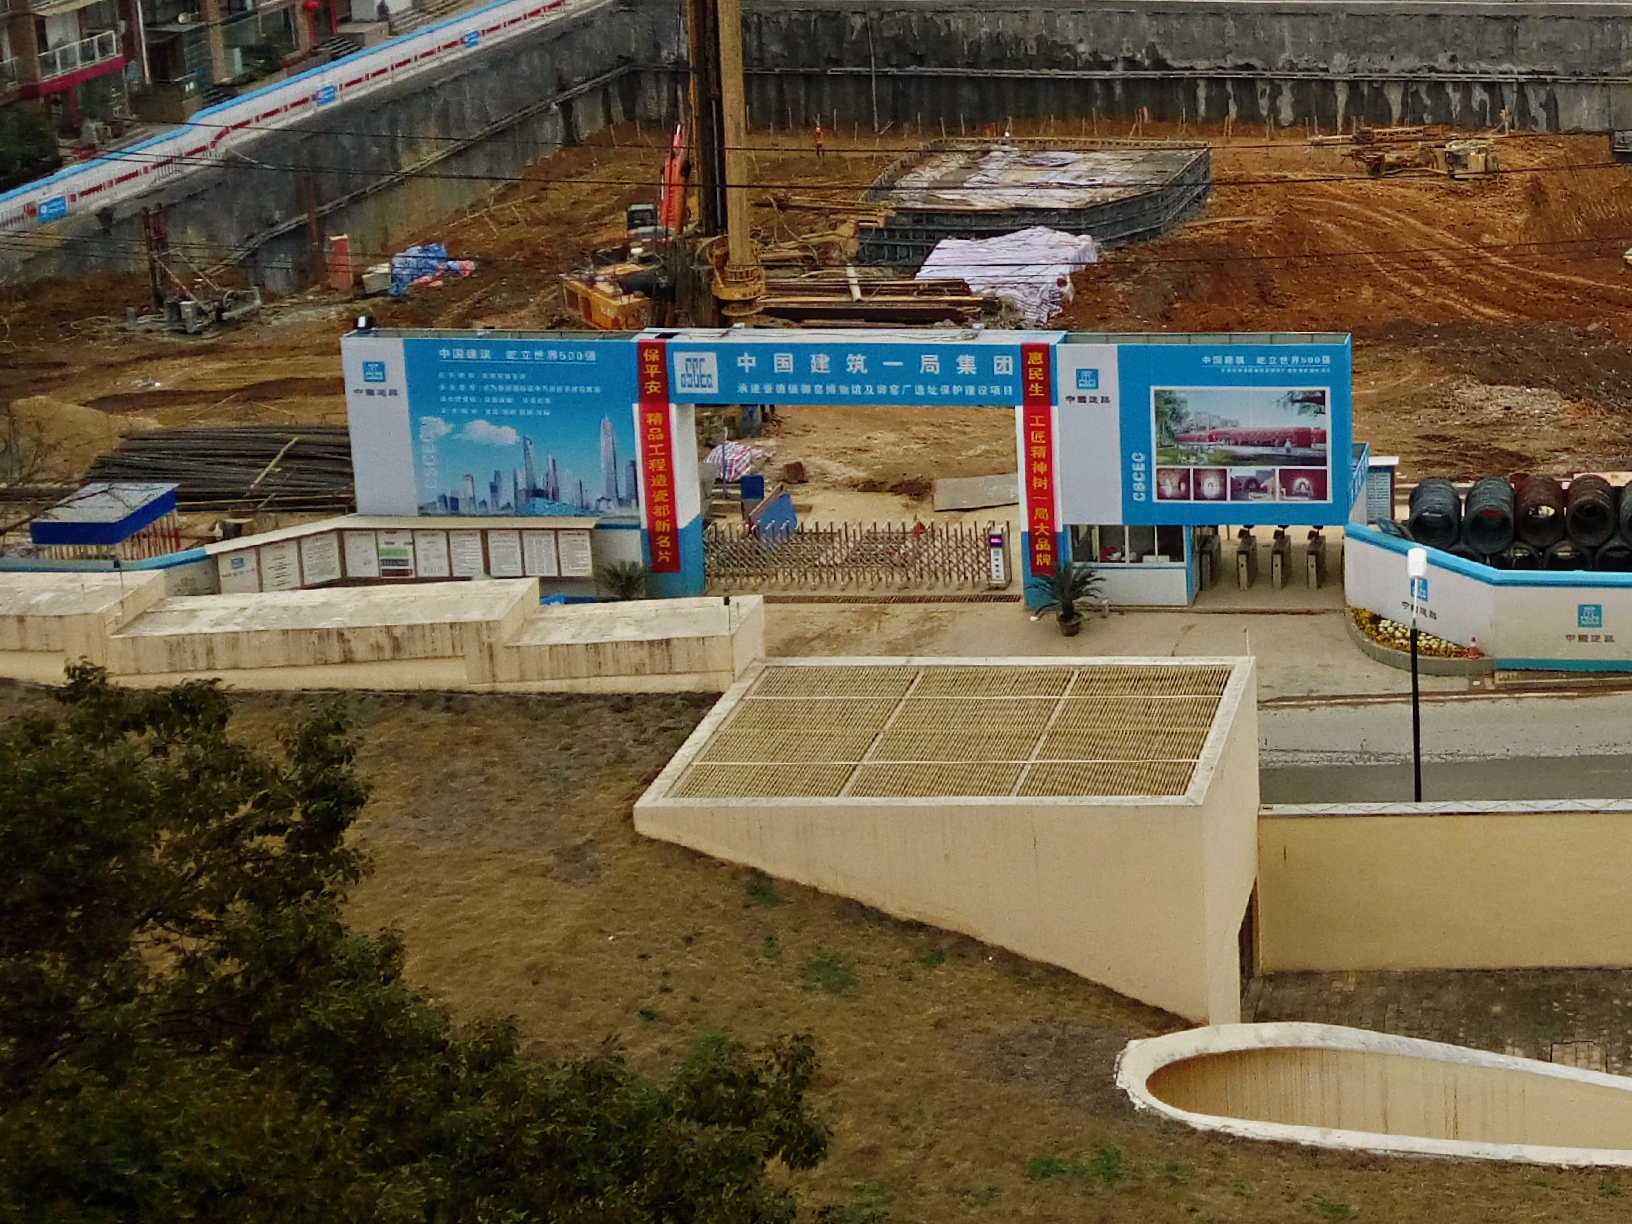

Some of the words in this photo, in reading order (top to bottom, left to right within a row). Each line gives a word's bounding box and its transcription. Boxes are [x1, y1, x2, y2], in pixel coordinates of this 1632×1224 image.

[439, 348, 491, 359] 中国建筑
[643, 348, 662, 394] 保平安
[737, 352, 1014, 375] 中国建筑一局集团
[1027, 351, 1045, 396] 惠民生
[1201, 355, 1245, 364] 中国建筑
[646, 412, 672, 563] 精品工程造瓷都新名片
[1030, 415, 1051, 566] 工匠精神树一局大品牌
[1131, 452, 1146, 502] CSCEC
